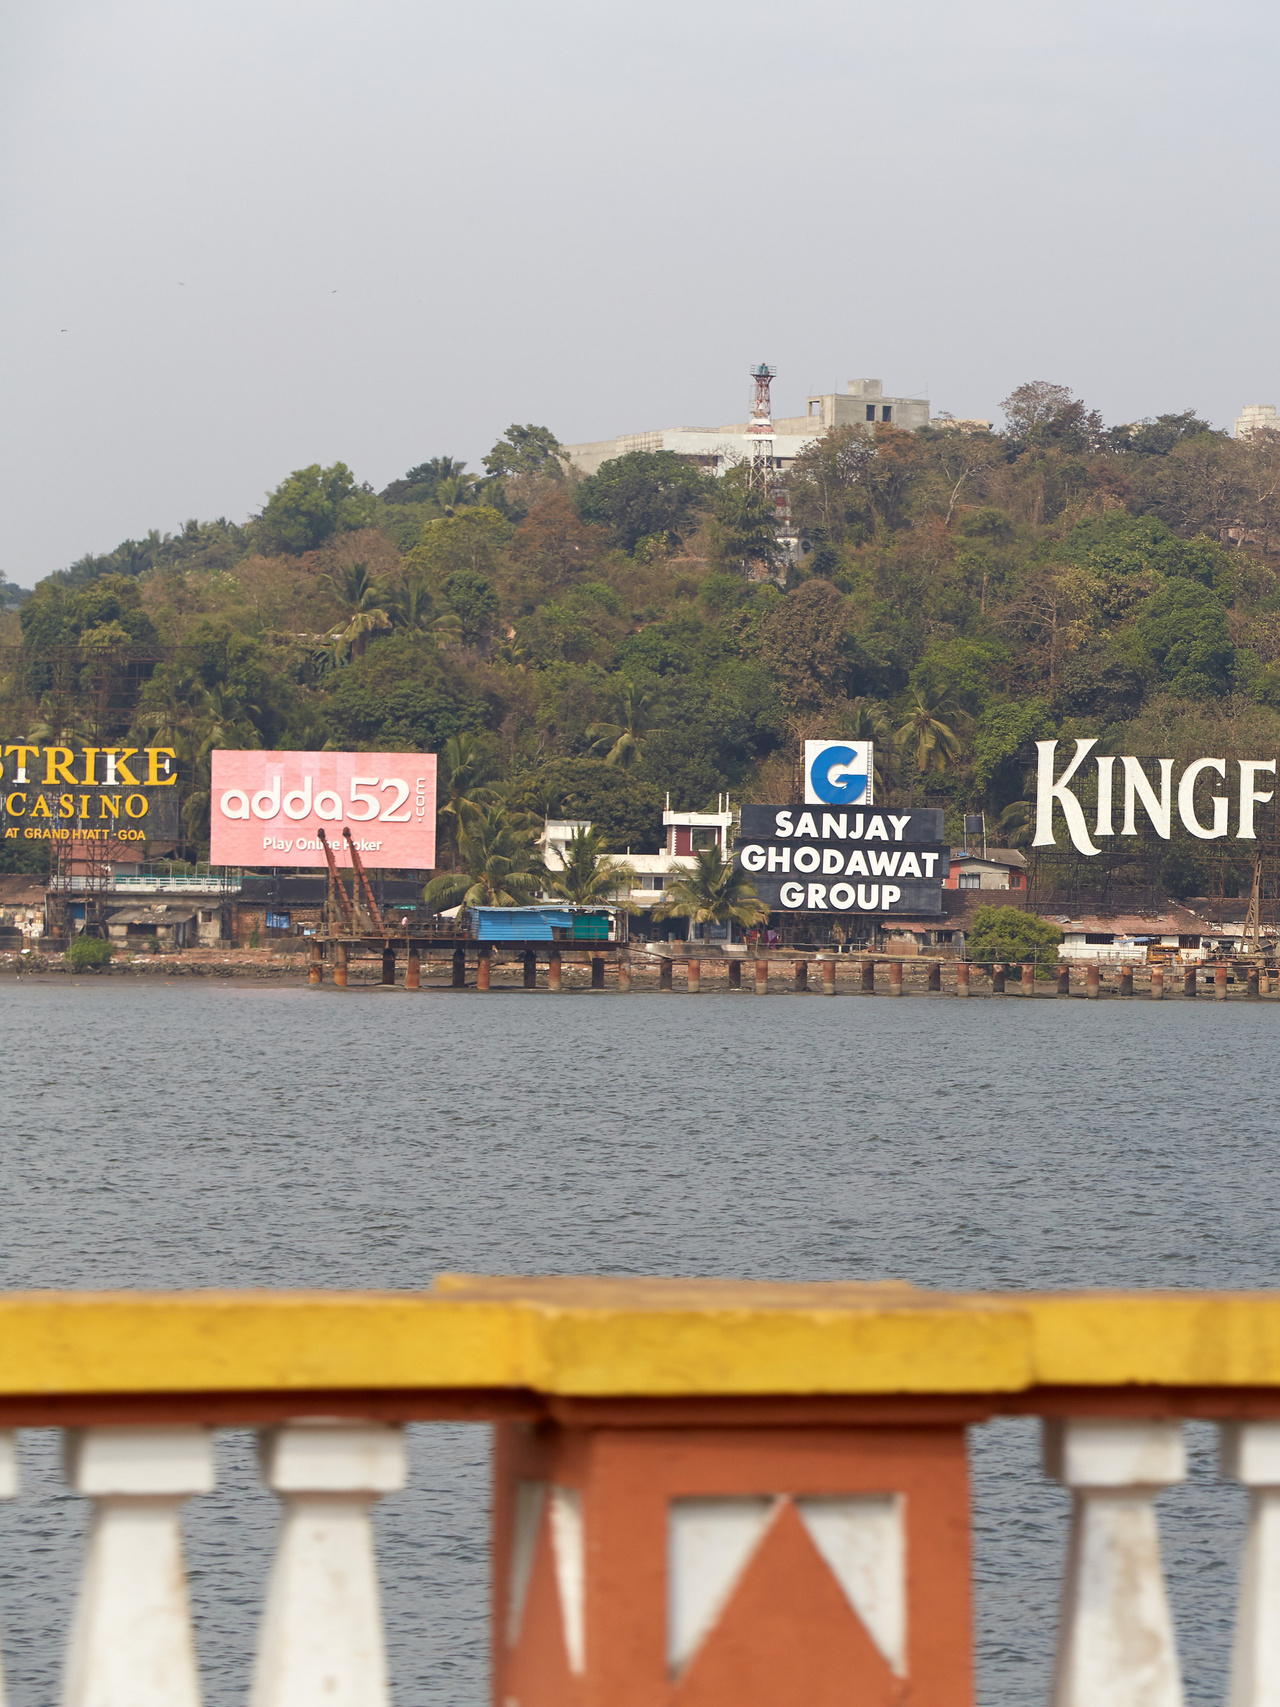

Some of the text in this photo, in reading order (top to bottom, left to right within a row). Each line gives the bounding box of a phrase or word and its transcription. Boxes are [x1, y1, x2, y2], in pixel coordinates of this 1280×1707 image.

[5, 792, 149, 819] CASINO
[220, 776, 412, 822] adda52
[4, 828, 20, 839] AT
[24, 828, 70, 840] GRAND
[72, 829, 110, 840] HYATT
[774, 811, 912, 841] SANJAY
[263, 837, 293, 852] Play
[740, 845, 939, 878] GHODAWAT
[779, 882, 901, 911] GROUP
